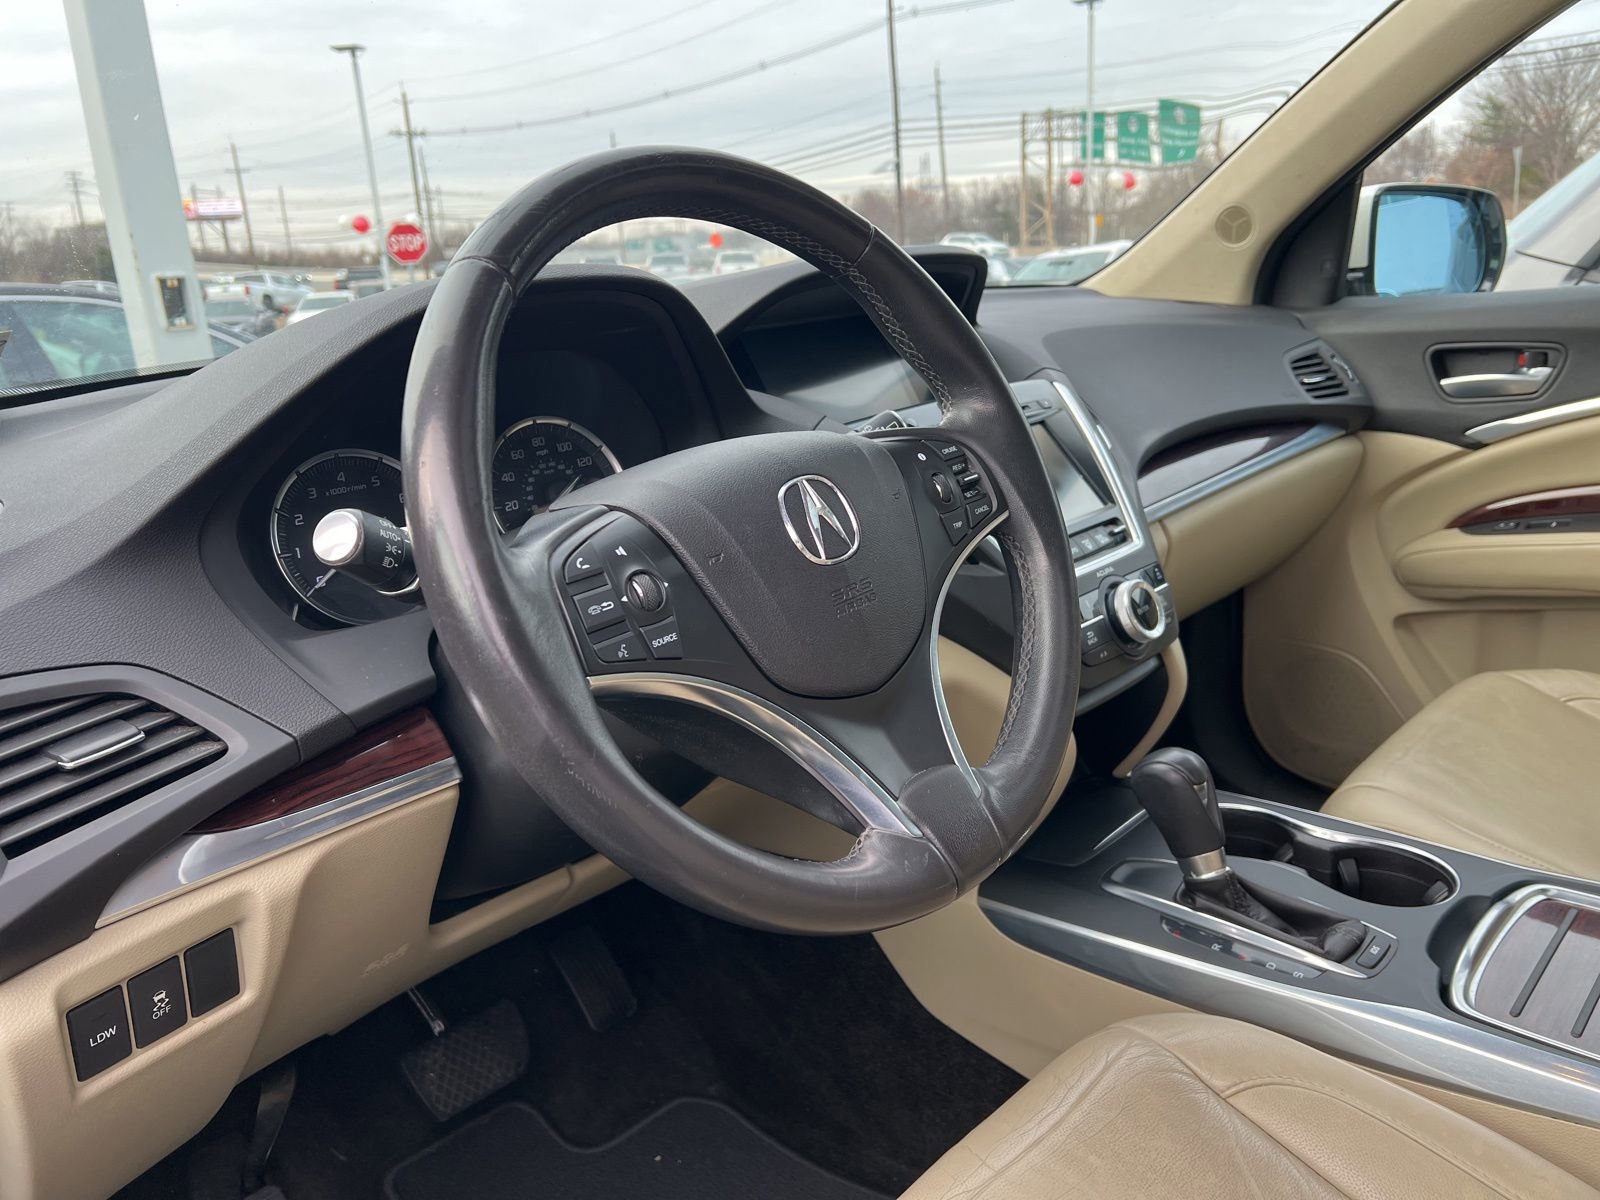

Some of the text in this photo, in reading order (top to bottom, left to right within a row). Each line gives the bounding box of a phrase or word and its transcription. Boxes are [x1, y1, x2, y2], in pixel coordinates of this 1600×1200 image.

[389, 234, 424, 252] STOP
[531, 436, 545, 447] 80
[556, 442, 572, 453] 100
[536, 449, 549, 457] mph
[576, 456, 592, 467] 120
[337, 471, 346, 482] 4
[371, 475, 380, 487] 5
[501, 472, 515, 482] 40
[308, 487, 317, 499] 3
[505, 500, 518, 512] 20
[294, 514, 304, 526] 2
[380, 529, 398, 541] AUTO
[295, 547, 301, 559] 1
[652, 632, 679, 648] SOURCE
[1211, 943, 1223, 951] R
[1265, 961, 1276, 970] D
[1292, 971, 1304, 979] S
[152, 1005, 172, 1020] OFF
[89, 1025, 117, 1047] LDW
